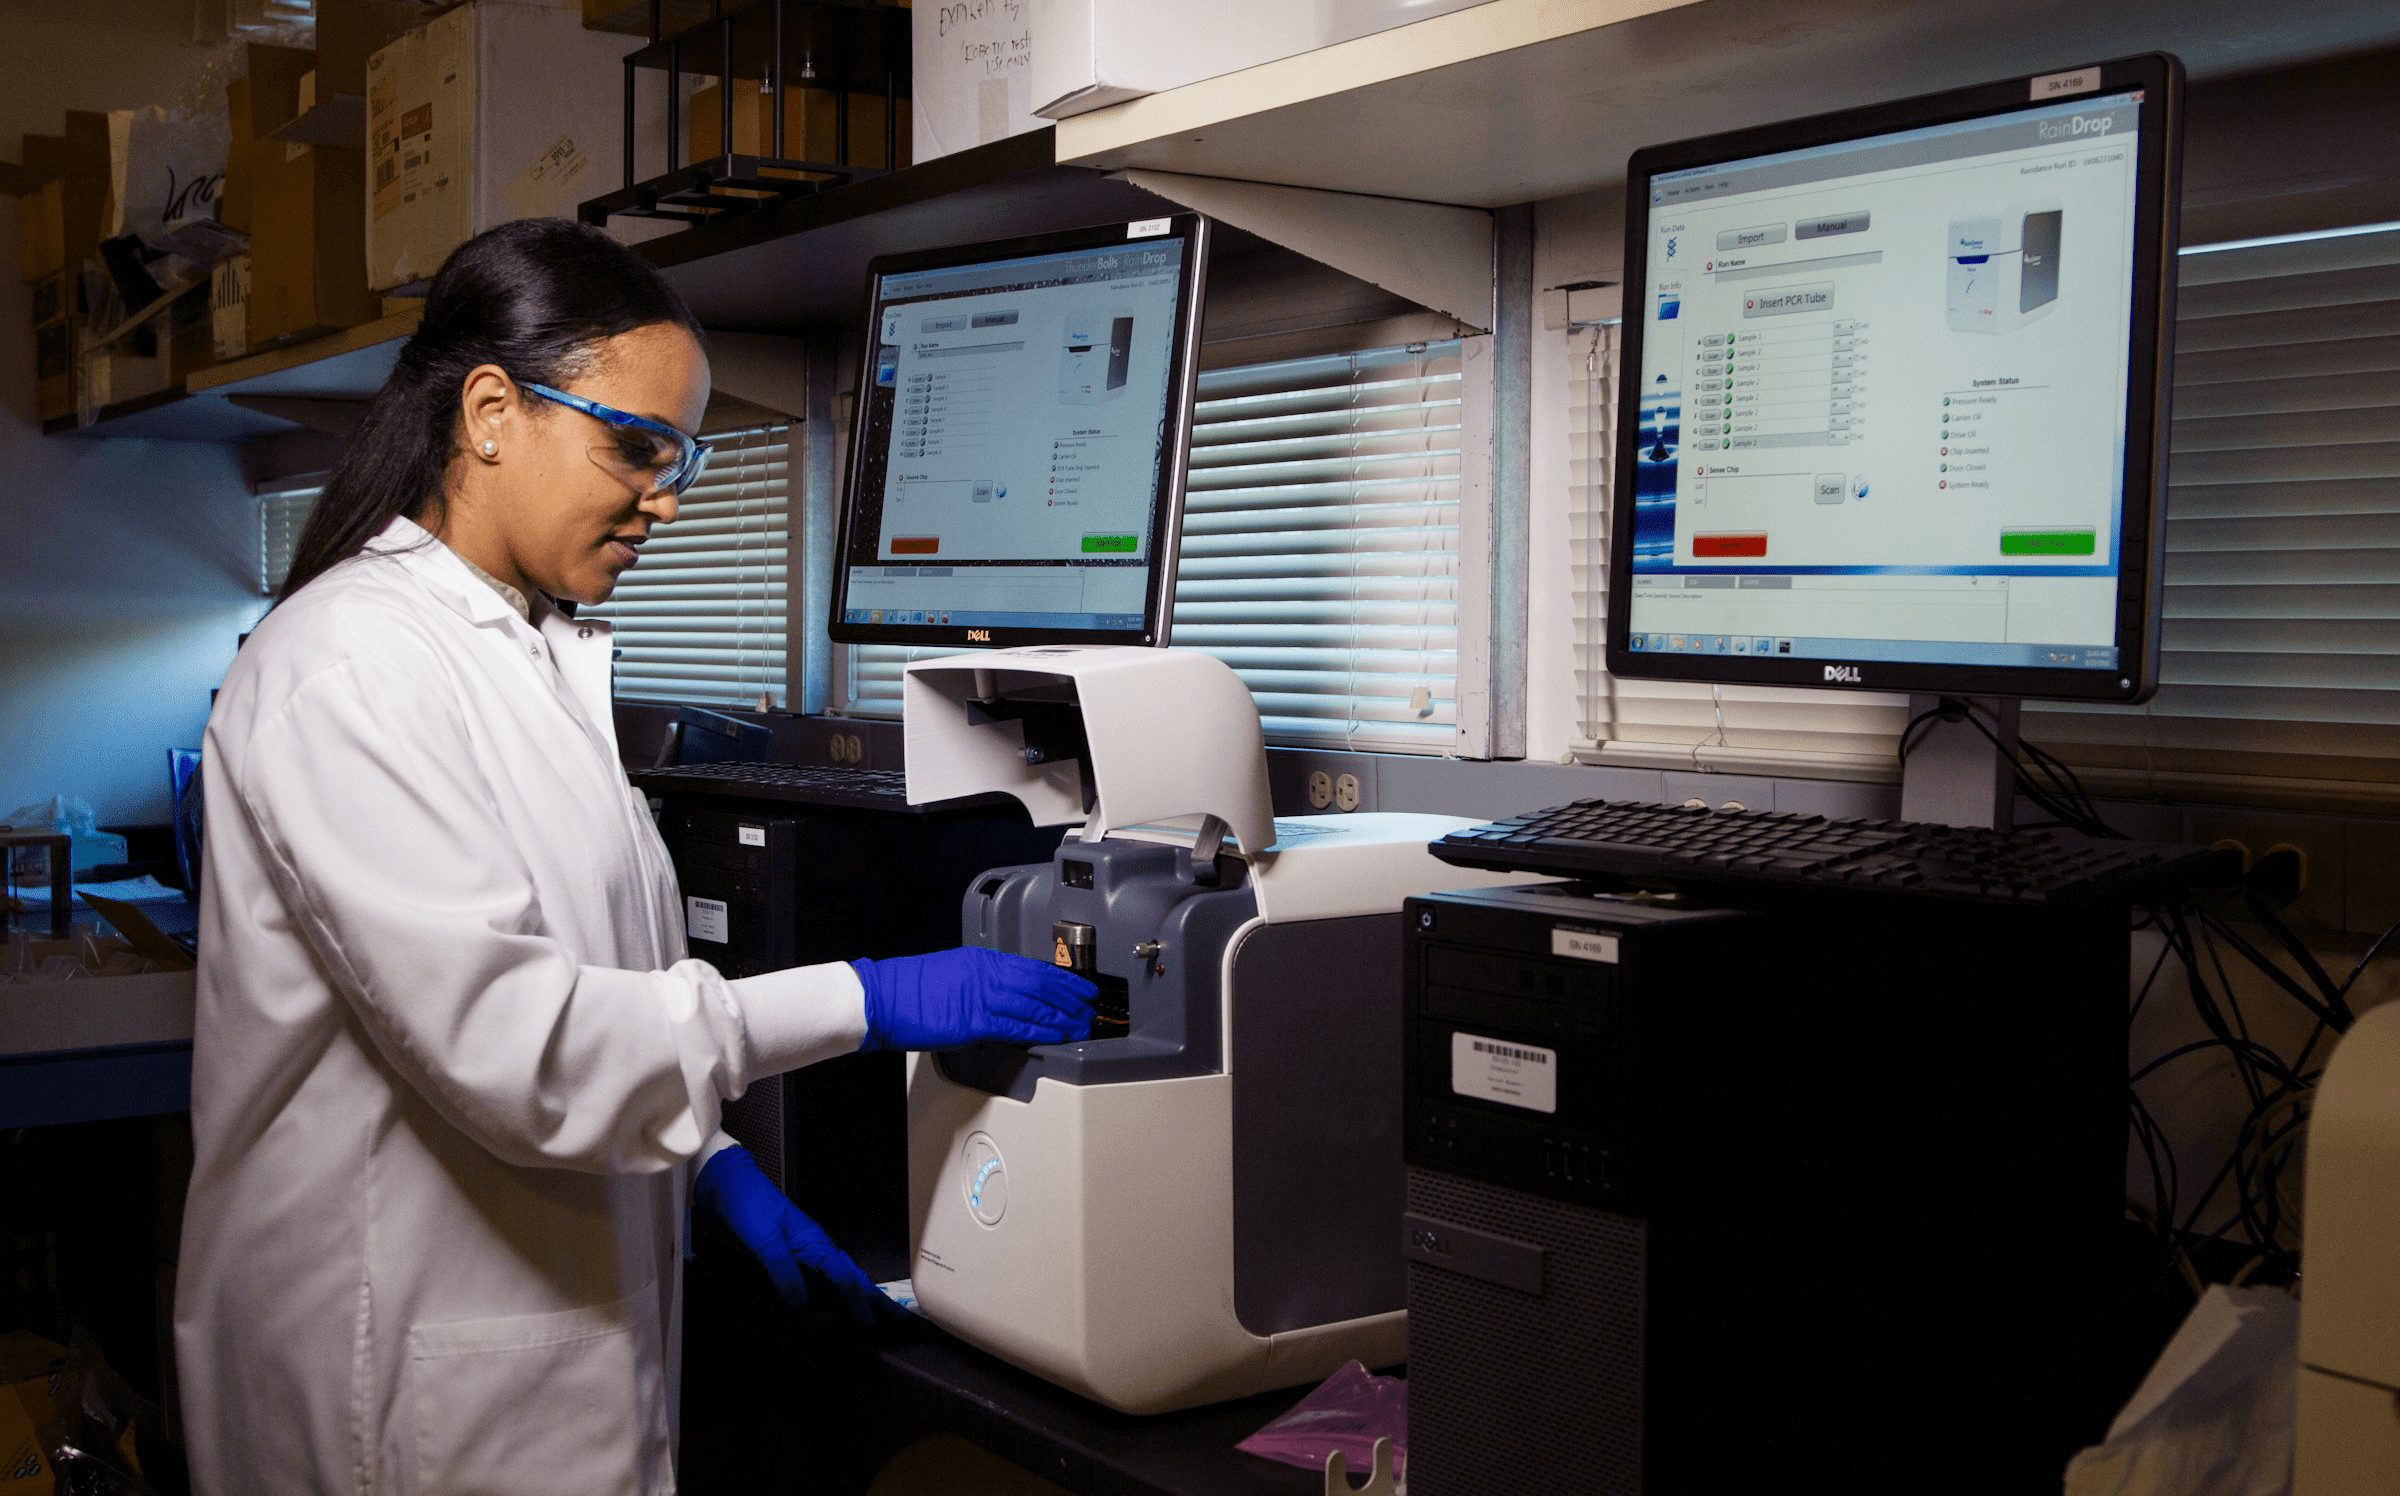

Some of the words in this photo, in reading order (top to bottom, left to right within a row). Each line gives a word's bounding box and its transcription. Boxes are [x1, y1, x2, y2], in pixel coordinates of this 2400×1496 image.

[2048, 82, 2060, 91] SN
[2063, 77, 2083, 88] 4169
[1818, 220, 1848, 232] Manual
[1738, 233, 1764, 245] Import
[1760, 298, 1784, 310] Insert
[1786, 295, 1803, 306] PCR
[1805, 293, 1827, 304] Tube
[935, 321, 952, 329] Import
[1973, 379, 1996, 388] System
[977, 488, 988, 496] Scan
[1821, 485, 1840, 495] Scan
[967, 630, 990, 641] DELL
[1824, 665, 1861, 682] DELL
